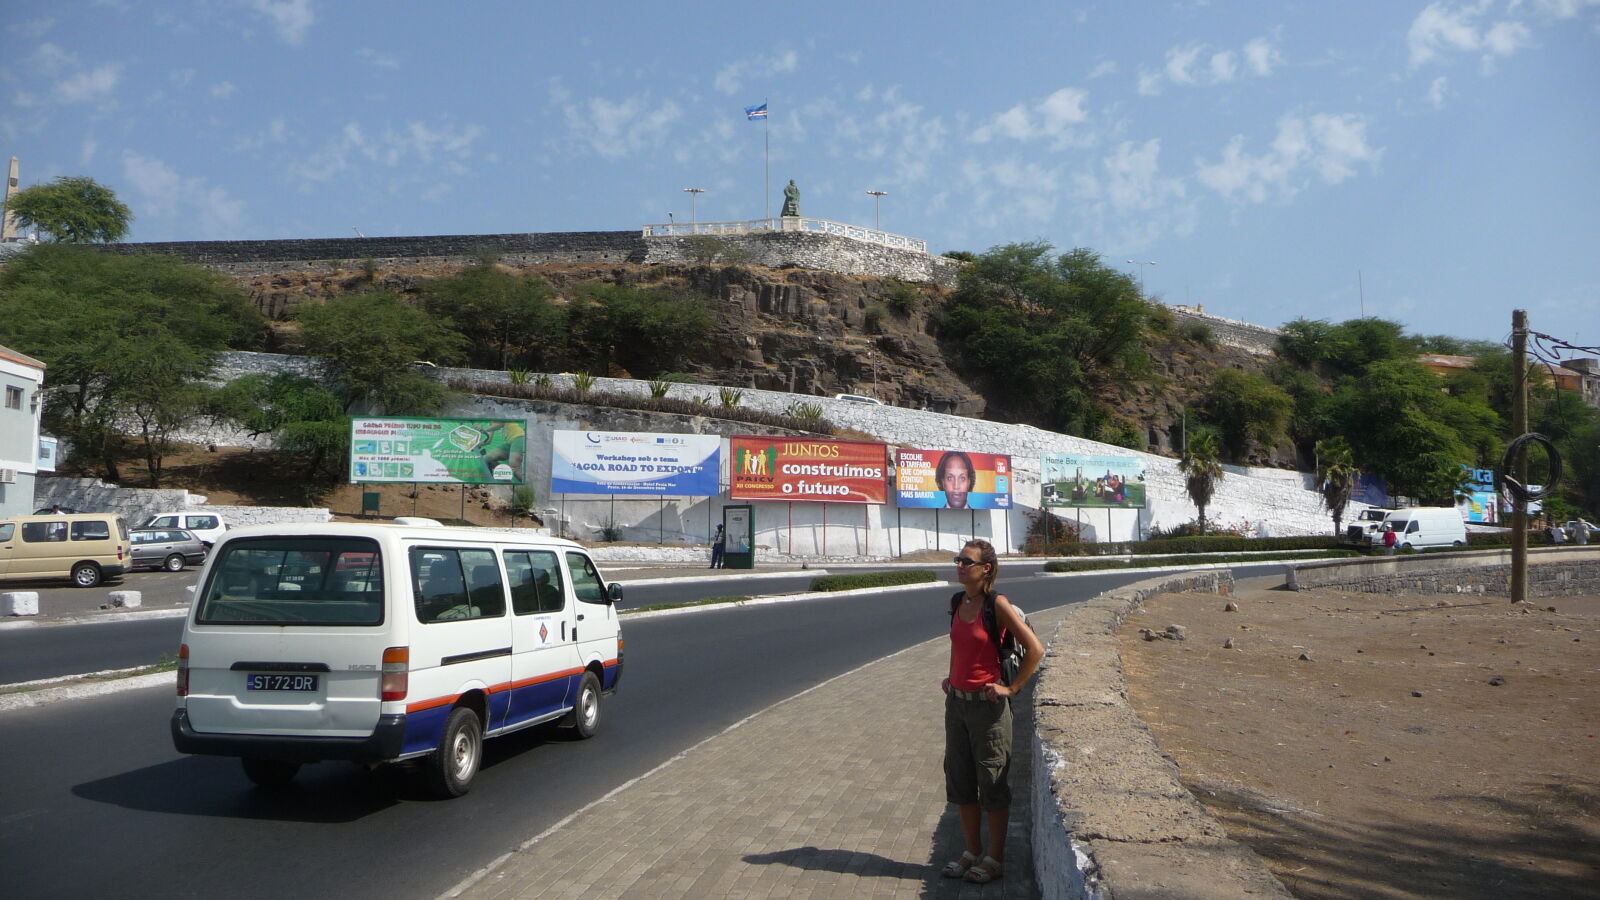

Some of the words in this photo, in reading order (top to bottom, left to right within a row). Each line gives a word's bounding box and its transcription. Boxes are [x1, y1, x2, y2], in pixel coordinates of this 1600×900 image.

[782, 443, 839, 458] JUNTOS
[596, 454, 637, 462] Workshop
[900, 453, 923, 461] ESCOLHE
[1046, 457, 1064, 465] Home
[608, 464, 638, 472] ROAD
[640, 464, 654, 472] TO
[782, 463, 882, 478] construímos
[901, 468, 912, 476] QUE
[736, 475, 775, 483] PAICV
[782, 483, 793, 494] o
[797, 480, 850, 495] futuro
